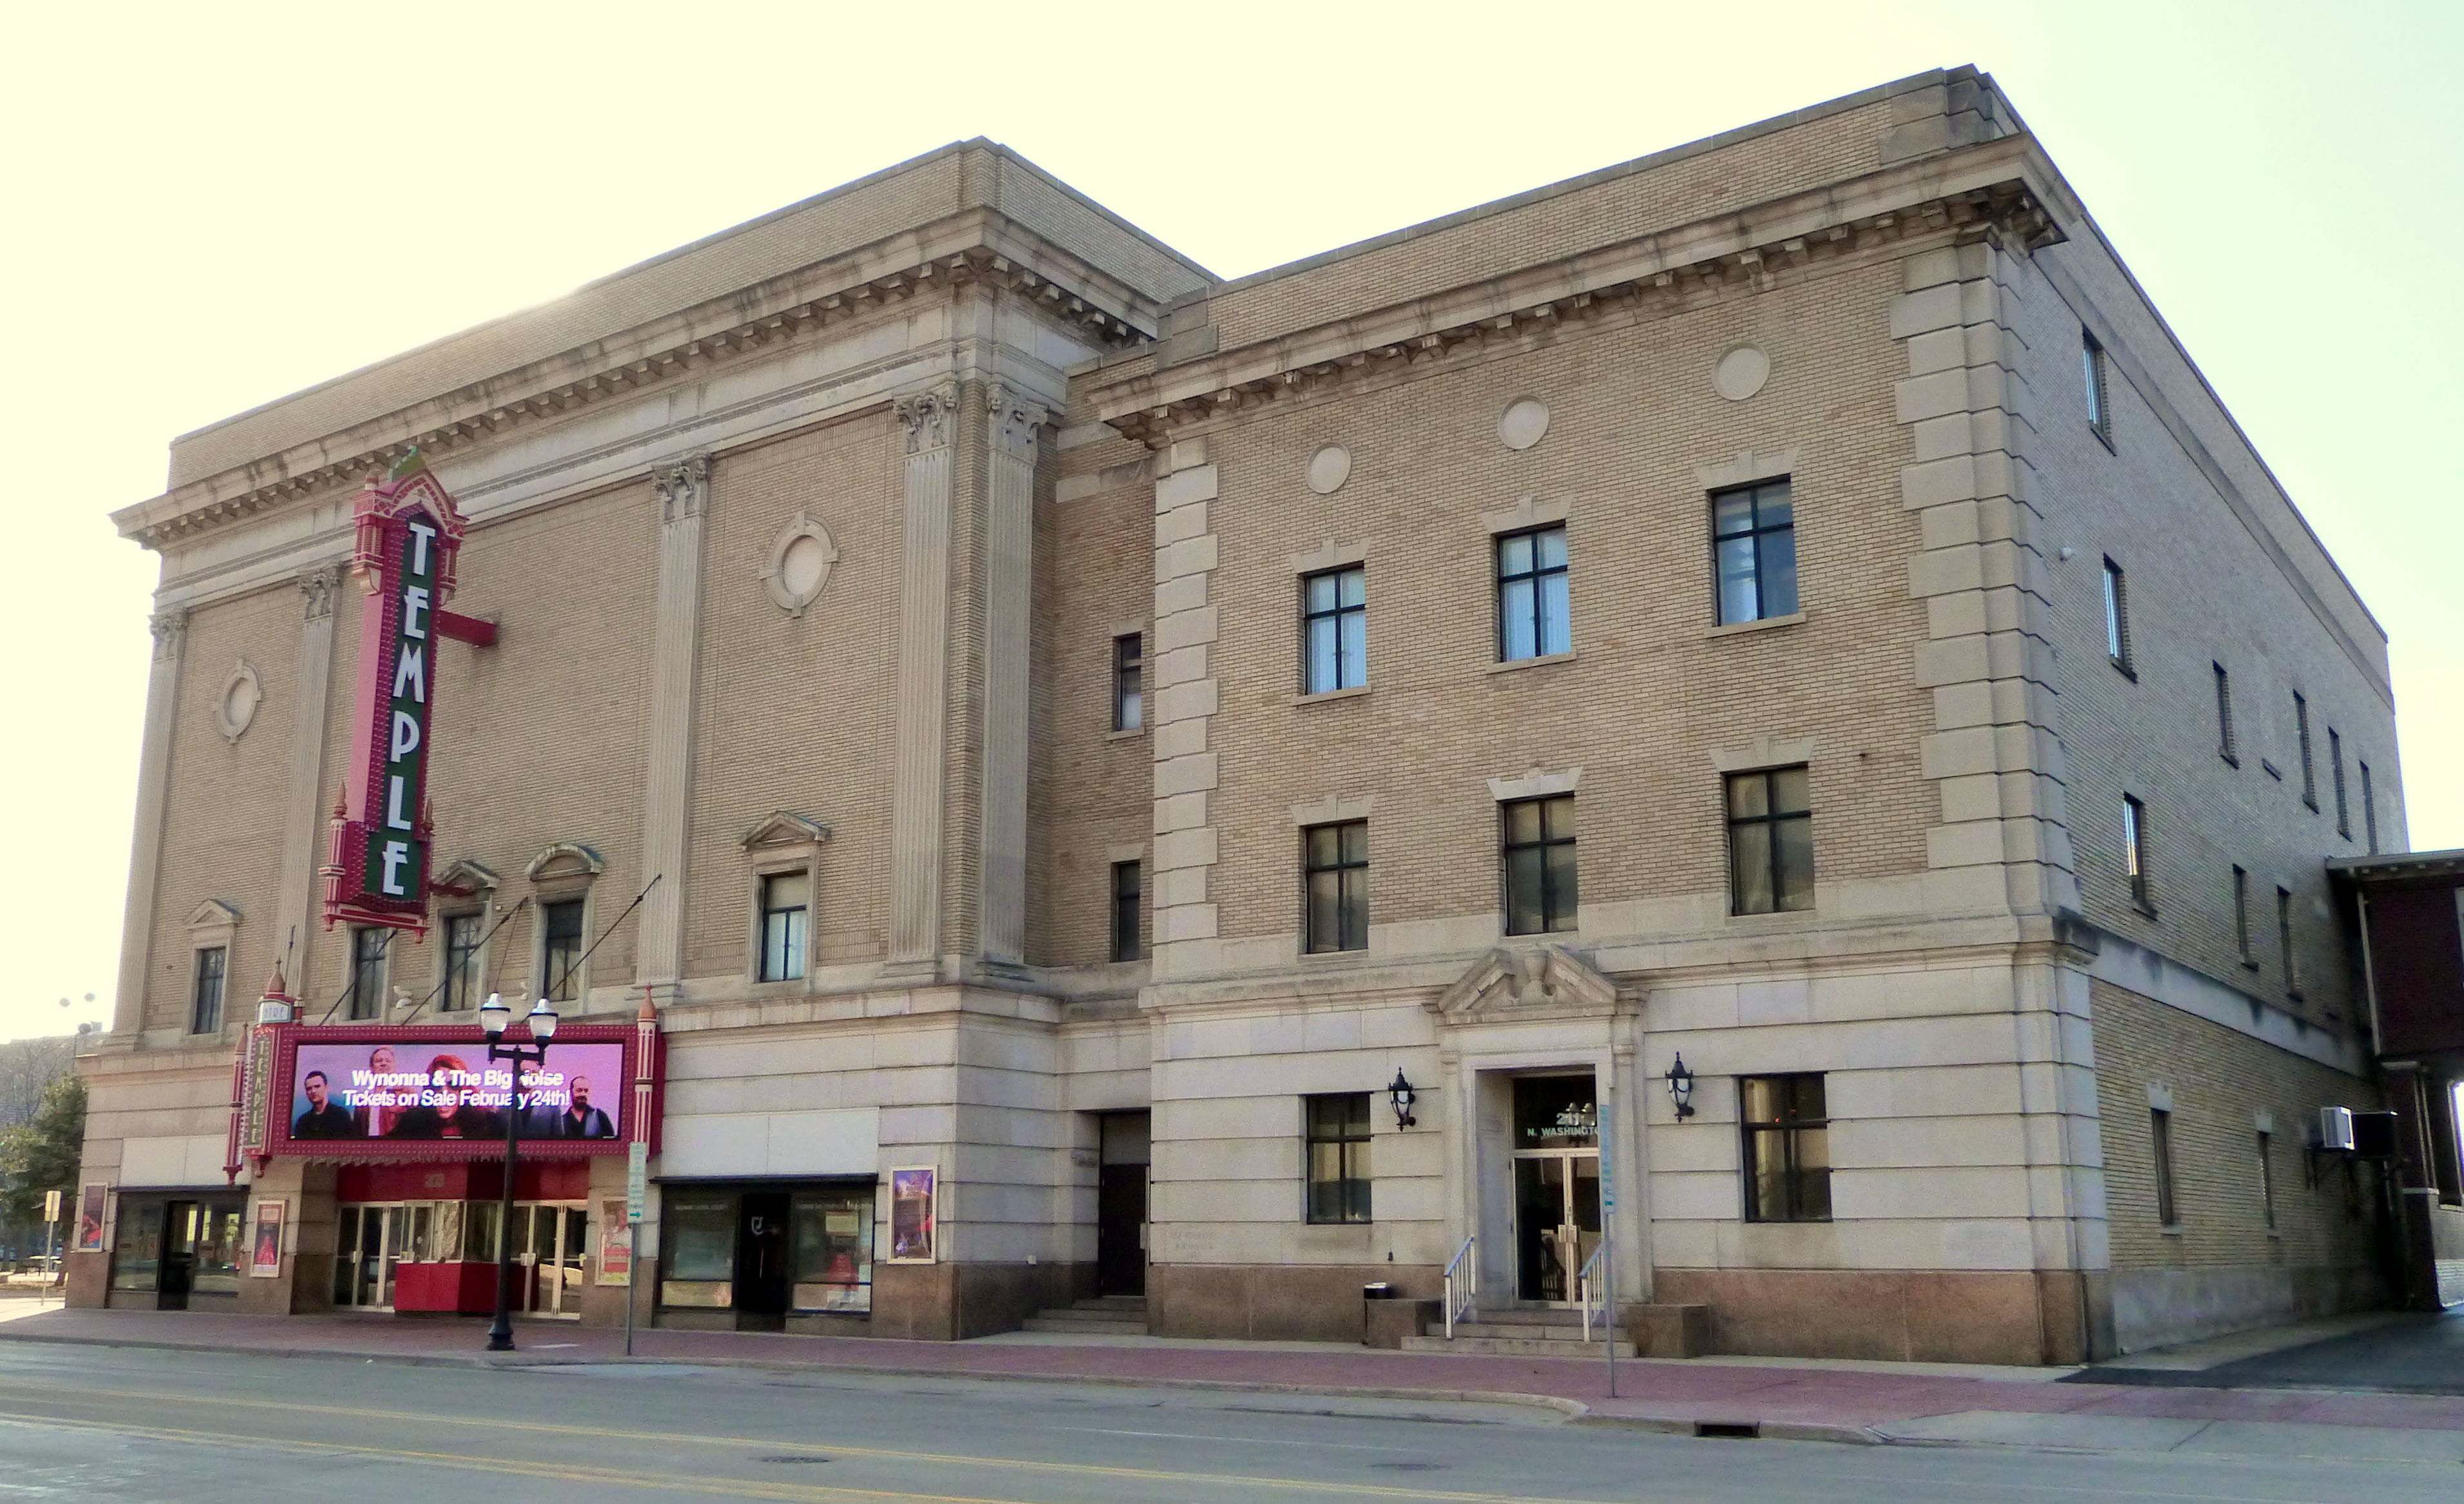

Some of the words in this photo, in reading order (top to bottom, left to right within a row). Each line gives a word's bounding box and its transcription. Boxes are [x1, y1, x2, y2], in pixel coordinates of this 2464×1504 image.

[382, 522, 436, 895] TEMPLE
[351, 1069, 429, 1089] Wynonna
[432, 1070, 446, 1086] &
[449, 1069, 482, 1086] The
[484, 1069, 513, 1089] Big
[251, 1040, 265, 1143] TEMPLE
[342, 1089, 395, 1106] Tickets
[397, 1093, 419, 1106] on
[420, 1089, 457, 1107] Sale
[459, 1089, 529, 1110] Februay
[530, 1089, 571, 1106] 24th!
[1556, 1112, 1580, 1126] 211
[1527, 1128, 1537, 1137] N.
